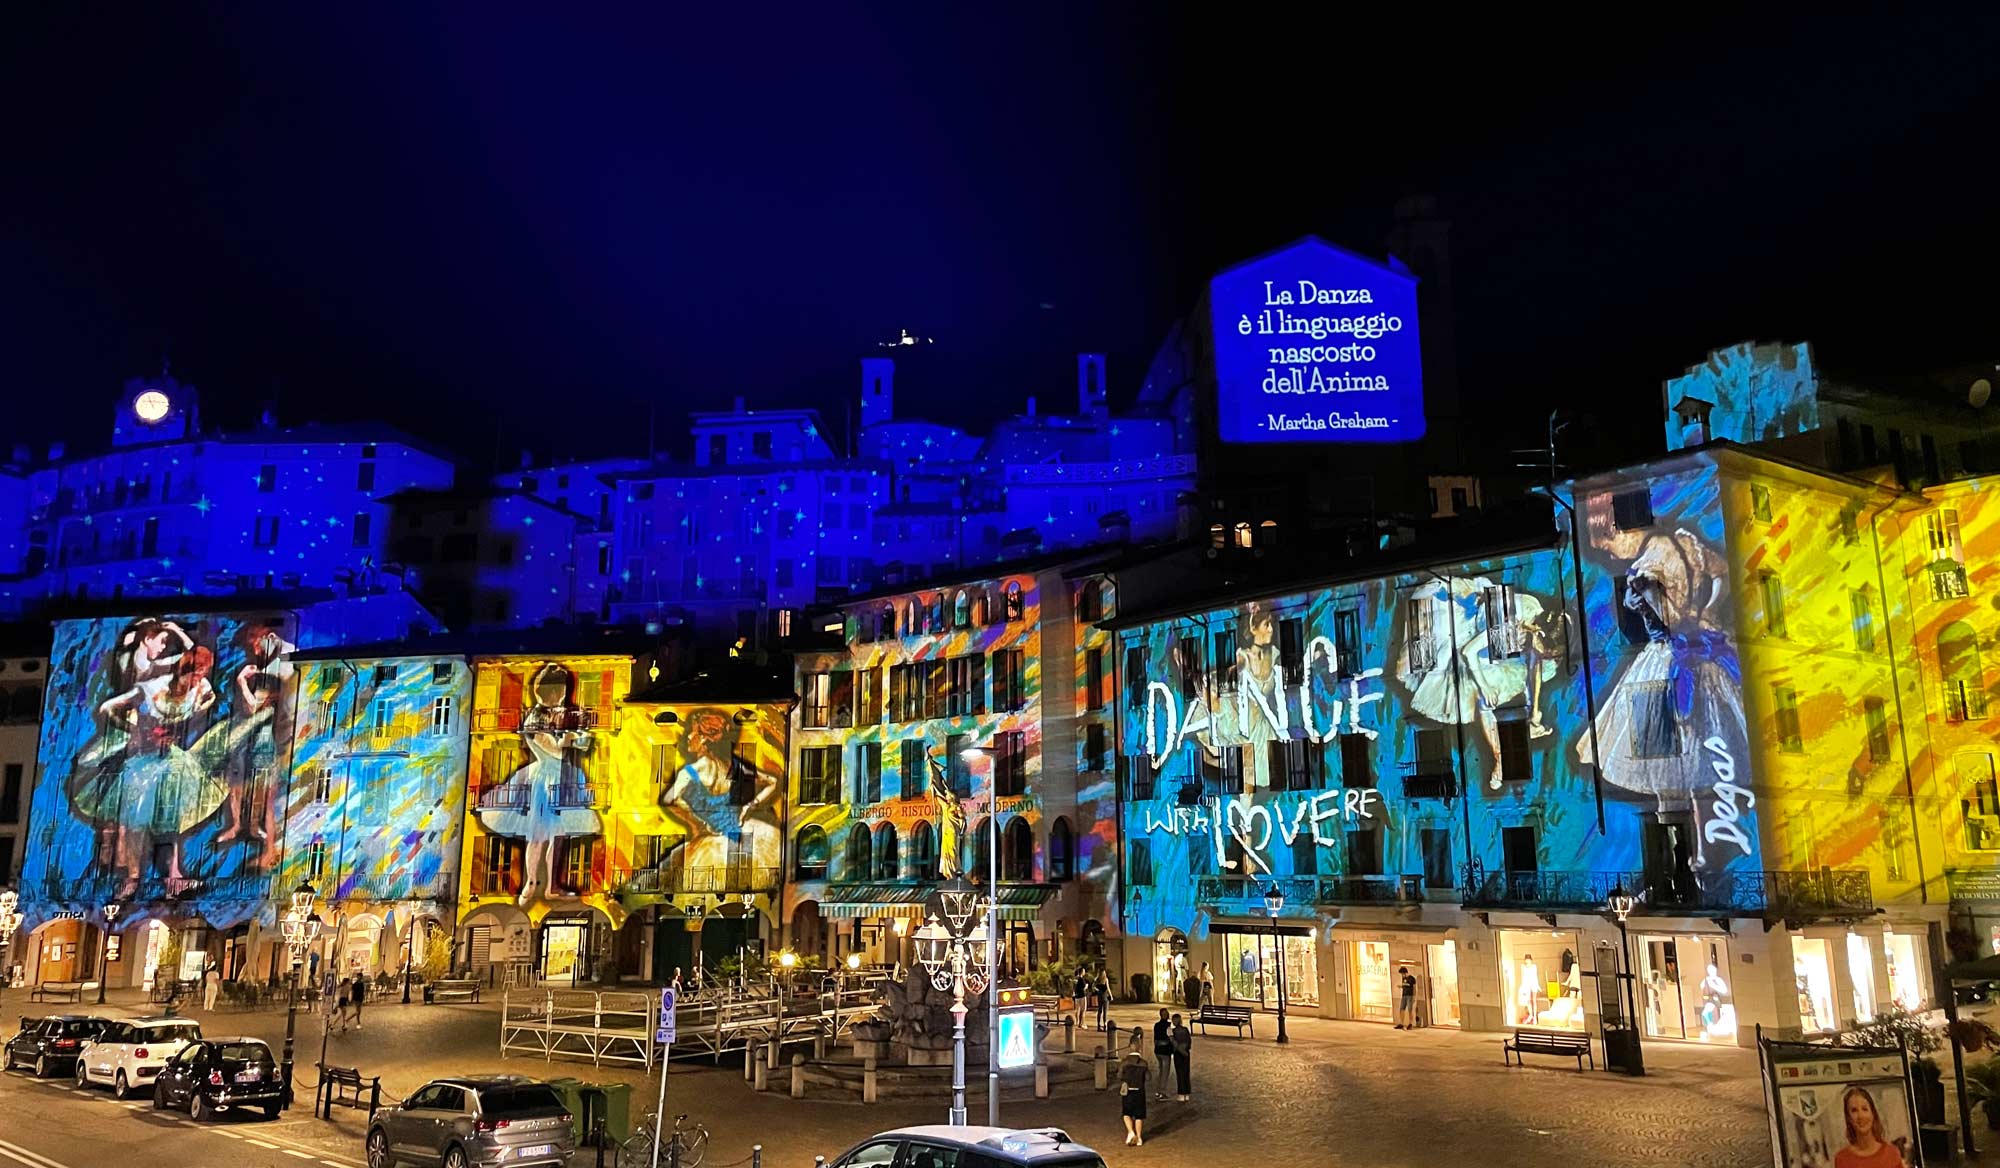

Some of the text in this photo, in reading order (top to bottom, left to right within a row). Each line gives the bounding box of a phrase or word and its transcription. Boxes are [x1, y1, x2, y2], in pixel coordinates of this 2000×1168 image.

[1264, 280, 1373, 305] La Danza
[1238, 309, 1402, 339] è il linguaggio
[1268, 342, 1376, 364] nascosto
[1262, 366, 1389, 394] dell'Anima
[1268, 413, 1326, 430] Martha
[1329, 412, 1389, 429] Graham
[1146, 636, 1384, 770] DANCE
[1704, 736, 1755, 855] Degas
[847, 806, 893, 819] ALBERGO
[52, 911, 86, 919] OTTICA
